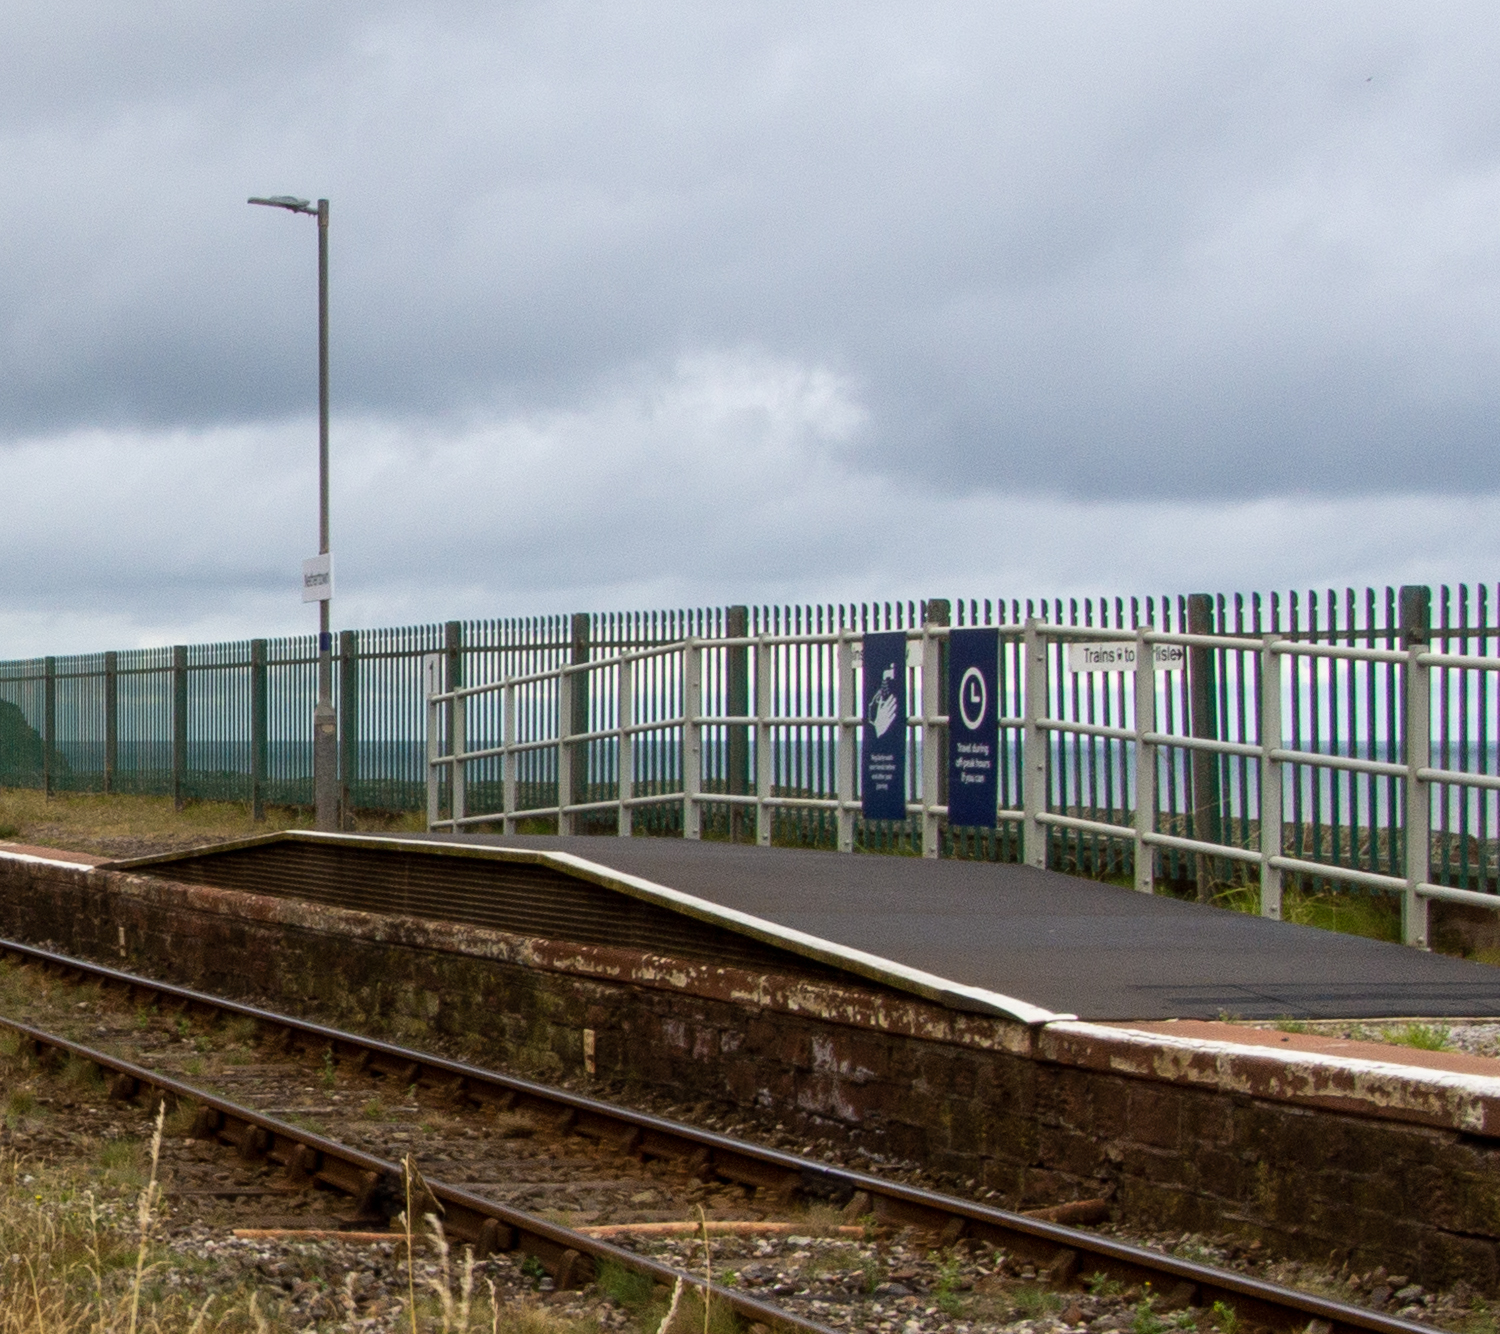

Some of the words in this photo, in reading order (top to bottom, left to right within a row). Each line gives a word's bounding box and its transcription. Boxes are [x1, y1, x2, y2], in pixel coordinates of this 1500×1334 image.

[1084, 647, 1115, 663] Trains
[1124, 647, 1135, 662] to
[957, 742, 971, 753] Travel
[972, 742, 989, 756] during
[975, 758, 990, 768] hours
